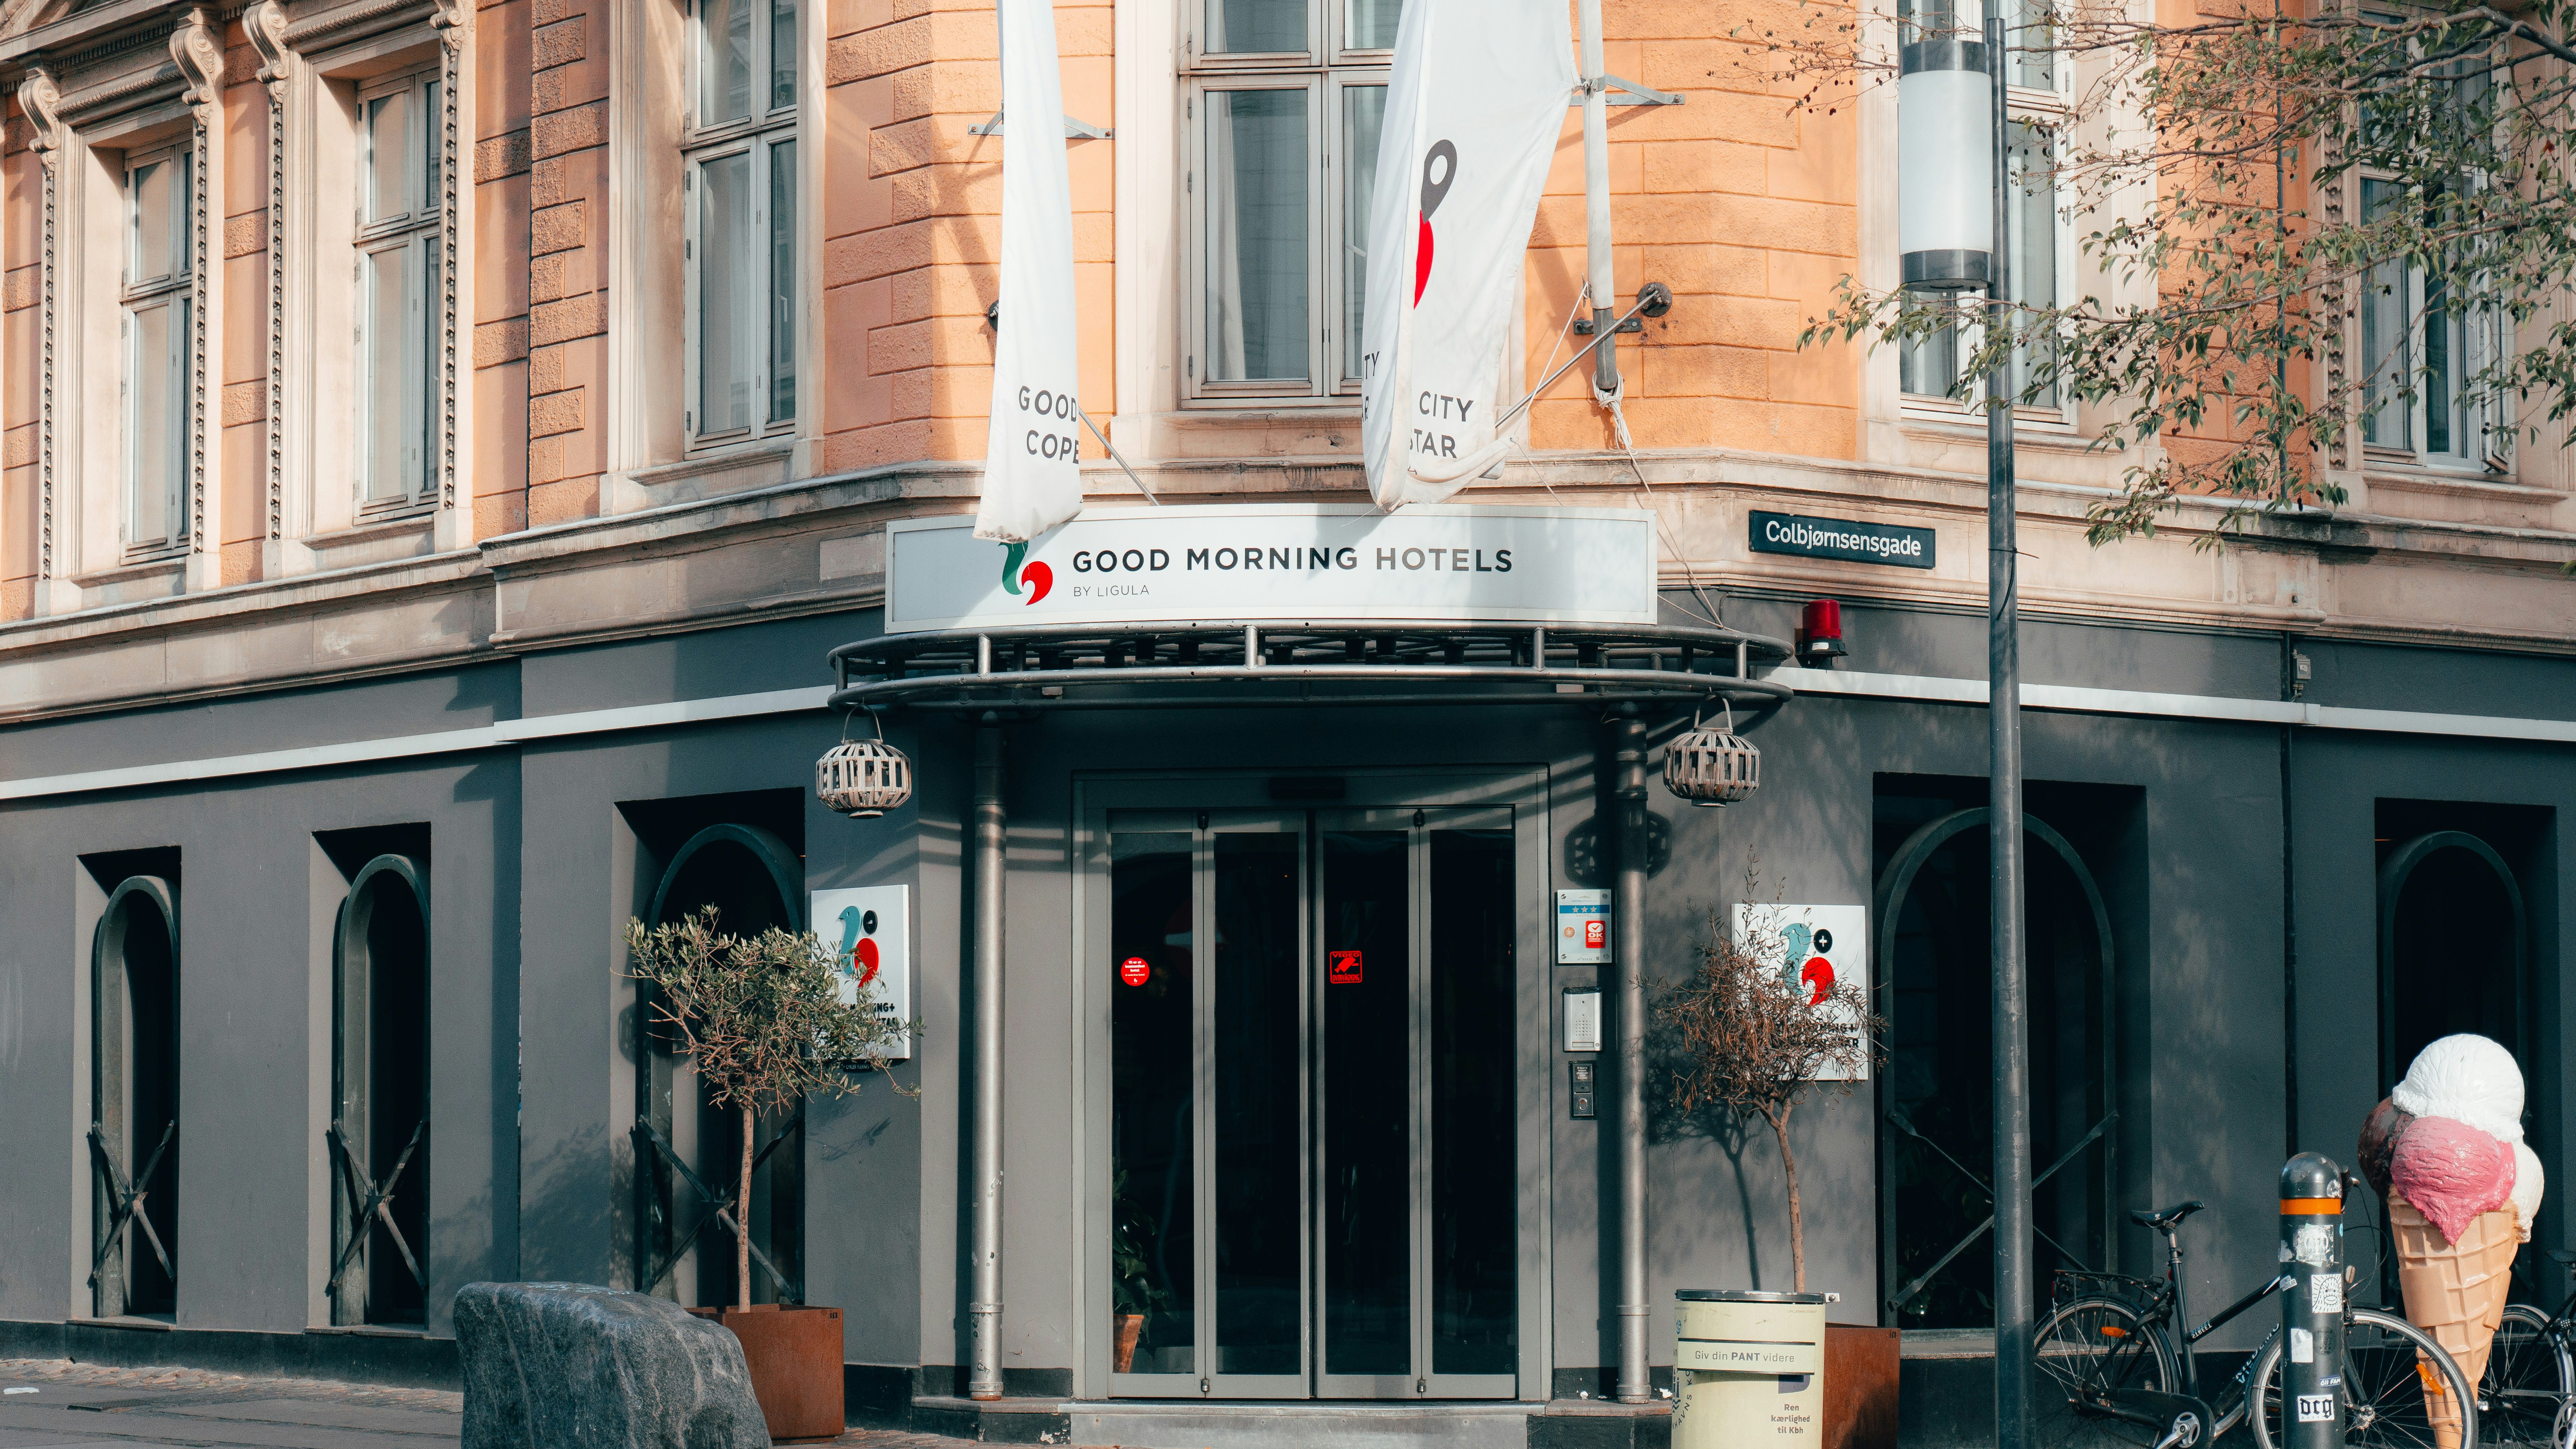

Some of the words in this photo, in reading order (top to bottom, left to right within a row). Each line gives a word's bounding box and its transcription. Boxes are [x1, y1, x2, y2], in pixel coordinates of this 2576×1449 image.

[1019, 385, 1076, 422] GOOD
[1419, 391, 1474, 422] CITY
[1766, 521, 1921, 557] Colbjørnsensgade
[1073, 549, 1170, 573] GOOD
[1187, 547, 1357, 570] MORNING
[1376, 548, 1512, 572] HOTELS
[1073, 586, 1091, 597] BY
[1098, 585, 1149, 597] LIGULA
[1333, 973, 1360, 981] OVERVÅGNING
[1695, 1351, 1709, 1360] Giv
[1712, 1351, 1728, 1360] din
[1731, 1352, 1760, 1361] PANT
[1763, 1353, 1795, 1362] videre
[1771, 1415, 1810, 1424] kærlighed
